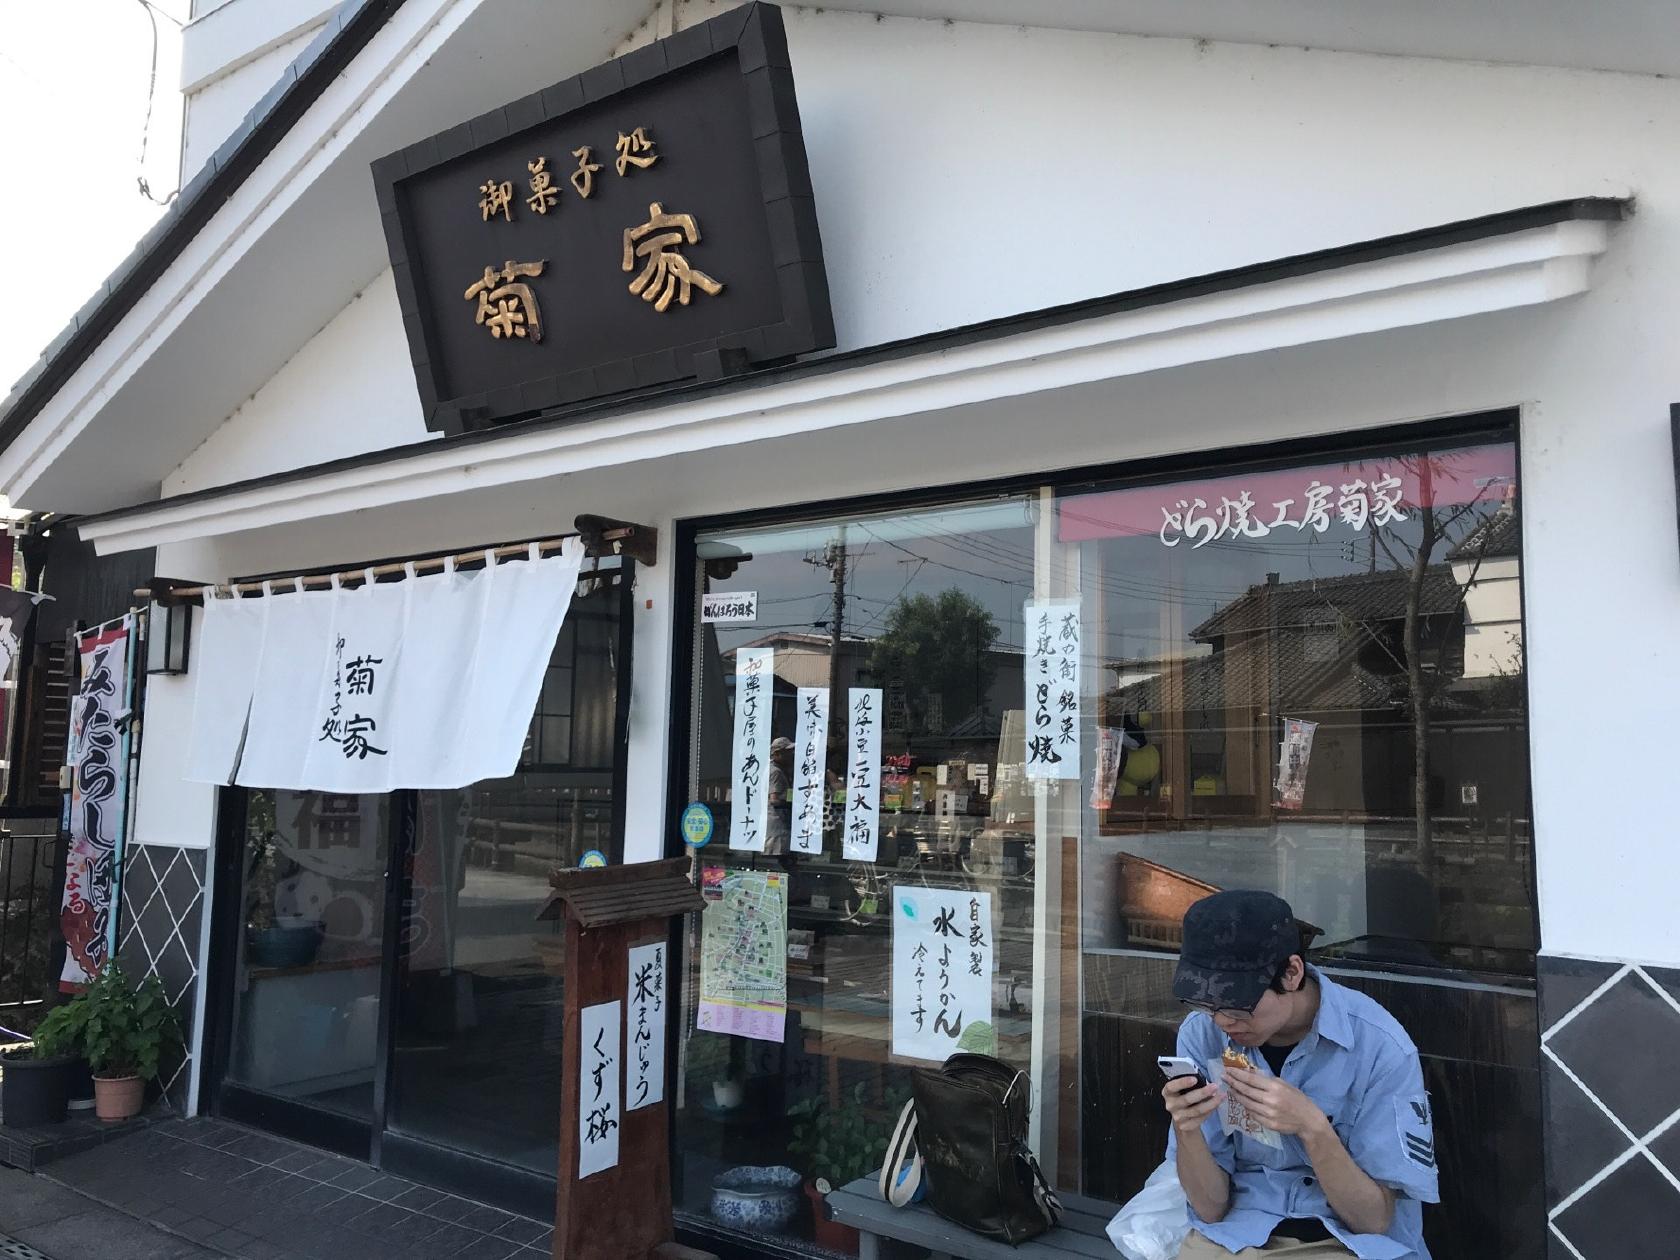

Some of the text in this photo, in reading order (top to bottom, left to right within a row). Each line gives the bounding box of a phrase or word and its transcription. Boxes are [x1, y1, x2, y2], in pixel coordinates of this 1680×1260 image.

[479, 127, 662, 221] 御菓子処
[465, 202, 726, 344] 菊家
[1159, 474, 1408, 548] どら焼工房菊家
[704, 600, 754, 618] がんばろう日本
[343, 655, 388, 759] 菊家
[1028, 612, 1062, 765] 手焼きどら焼
[911, 941, 928, 1033] 冷えてます
[933, 906, 965, 1039] 水ようかん
[968, 897, 988, 976] 自家製
[584, 1027, 618, 1144] くず桜
[633, 963, 655, 1106] 米まんじゅう
